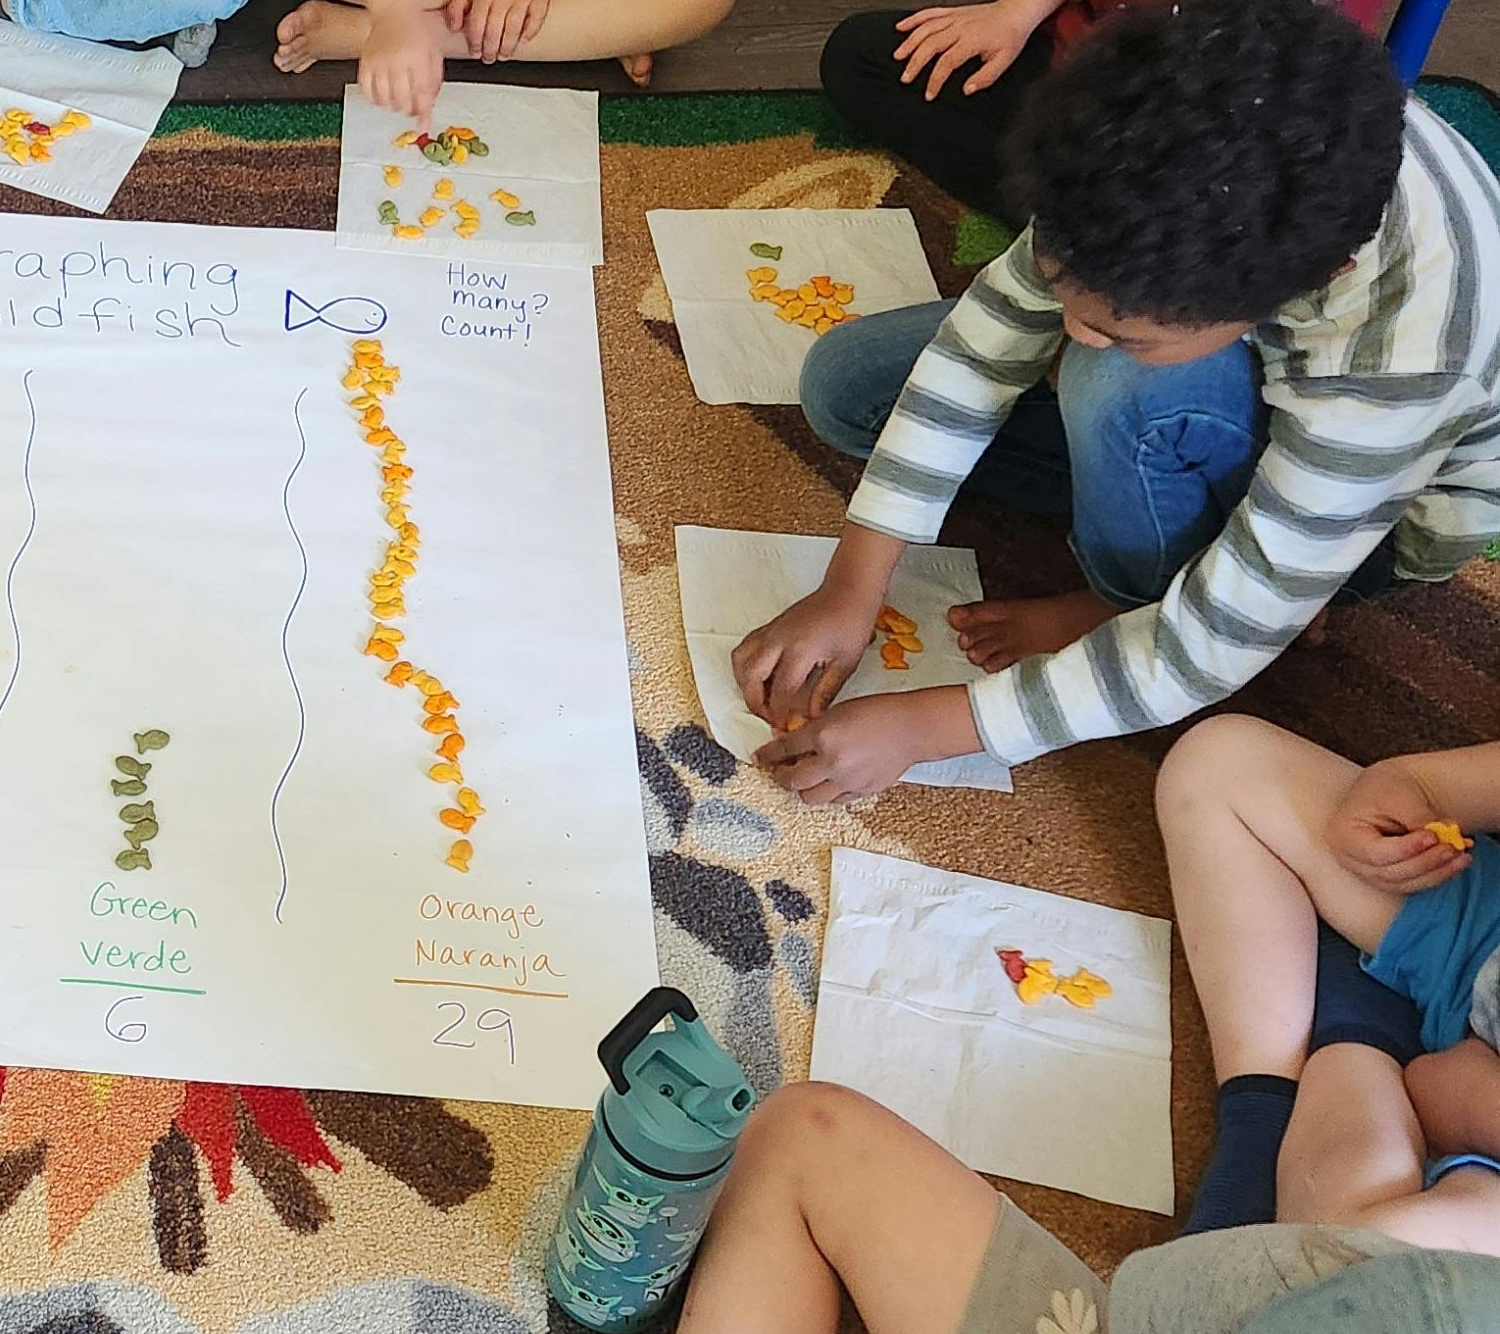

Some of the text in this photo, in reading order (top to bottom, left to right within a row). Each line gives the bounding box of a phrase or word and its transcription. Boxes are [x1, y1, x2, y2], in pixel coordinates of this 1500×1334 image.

[446, 262, 508, 290] How
[452, 289, 550, 324] many?
[440, 314, 532, 348] Count!
[90, 881, 198, 929] Green
[419, 893, 545, 940] Orange
[415, 938, 568, 987] Naranja
[105, 995, 148, 1043] 6
[432, 1001, 516, 1066] 29
